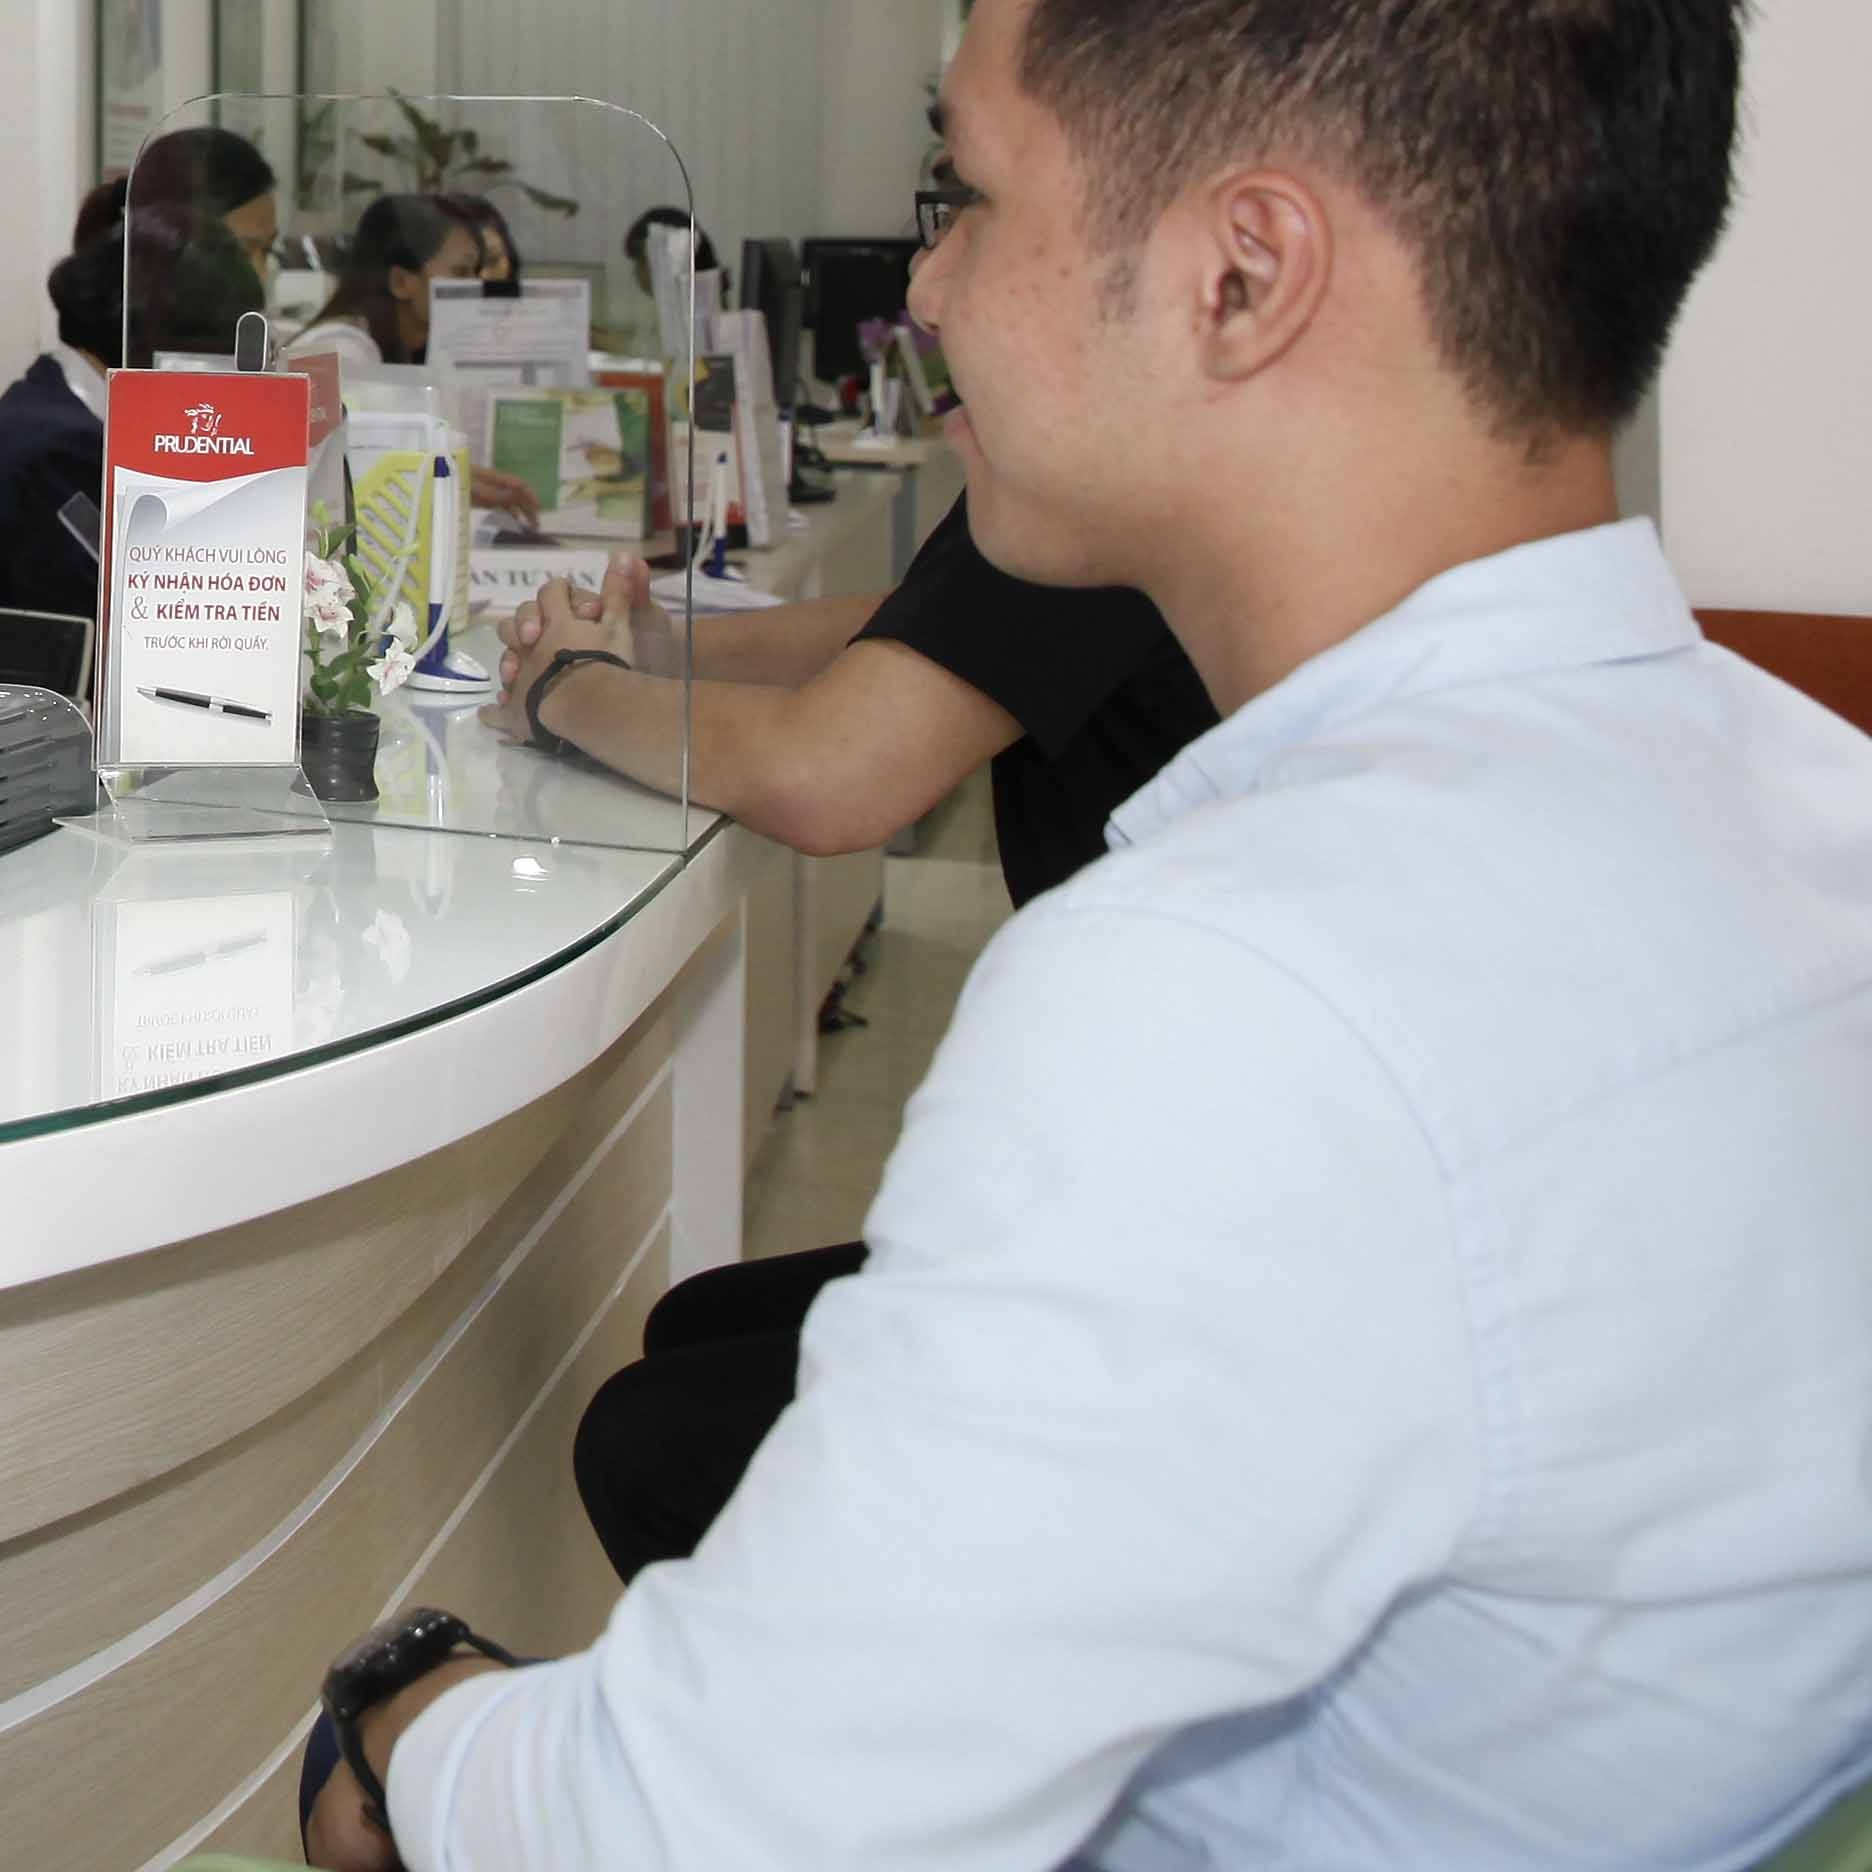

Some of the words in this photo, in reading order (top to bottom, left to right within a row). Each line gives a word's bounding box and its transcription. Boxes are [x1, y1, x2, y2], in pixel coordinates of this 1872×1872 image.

[154, 434, 255, 455] PRUDENTIAL
[129, 545, 161, 562] QUÝ
[165, 545, 216, 563] KHÁCH
[219, 549, 243, 564] VUI
[247, 546, 287, 565] LÒNG
[128, 570, 150, 590] KÝ
[154, 571, 203, 595] NHẬN
[208, 572, 244, 591] HÓA
[248, 575, 286, 592] ĐƠN
[130, 595, 149, 620] &
[156, 598, 200, 620] KIỂM
[204, 604, 237, 621] TRA
[188, 636, 208, 649] KHI
